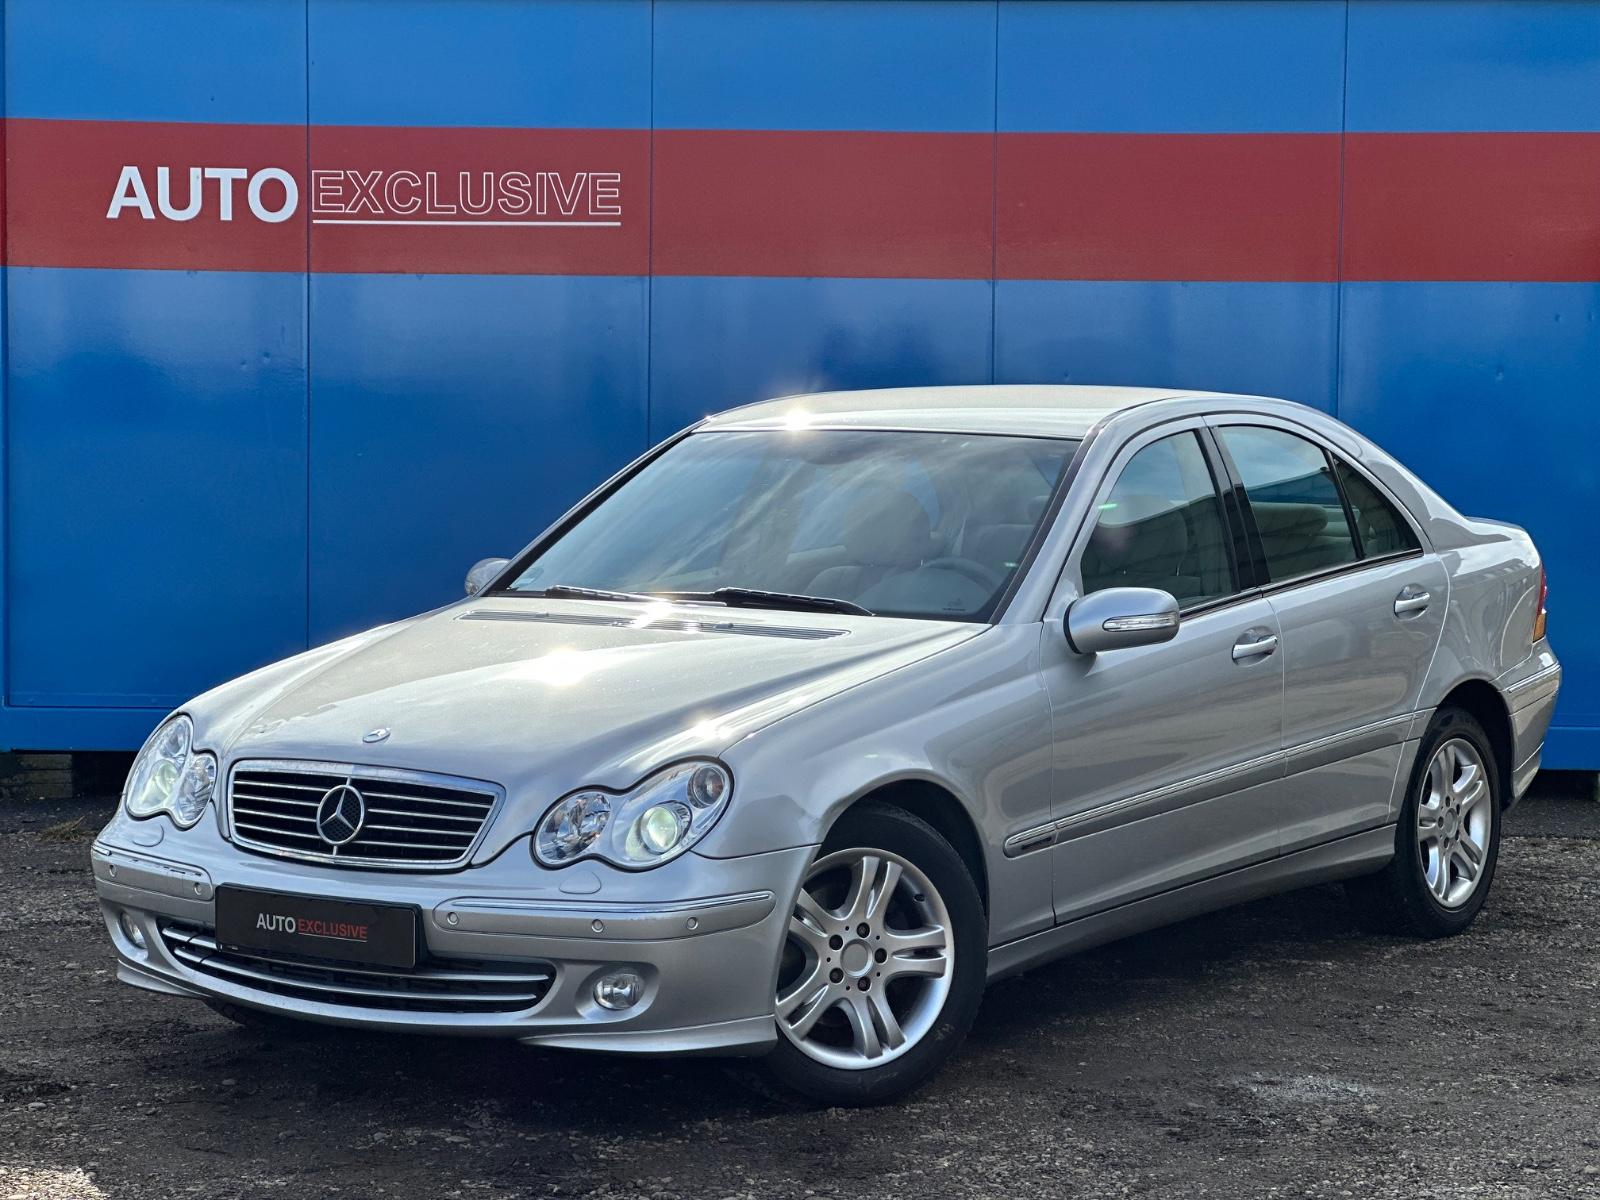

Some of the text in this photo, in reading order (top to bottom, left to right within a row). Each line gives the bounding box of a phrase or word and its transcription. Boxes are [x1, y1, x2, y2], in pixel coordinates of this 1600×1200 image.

[106, 166, 621, 222] AUTO EXCLUSIVE
[256, 913, 367, 938] AUTO EXCLUSIVE
